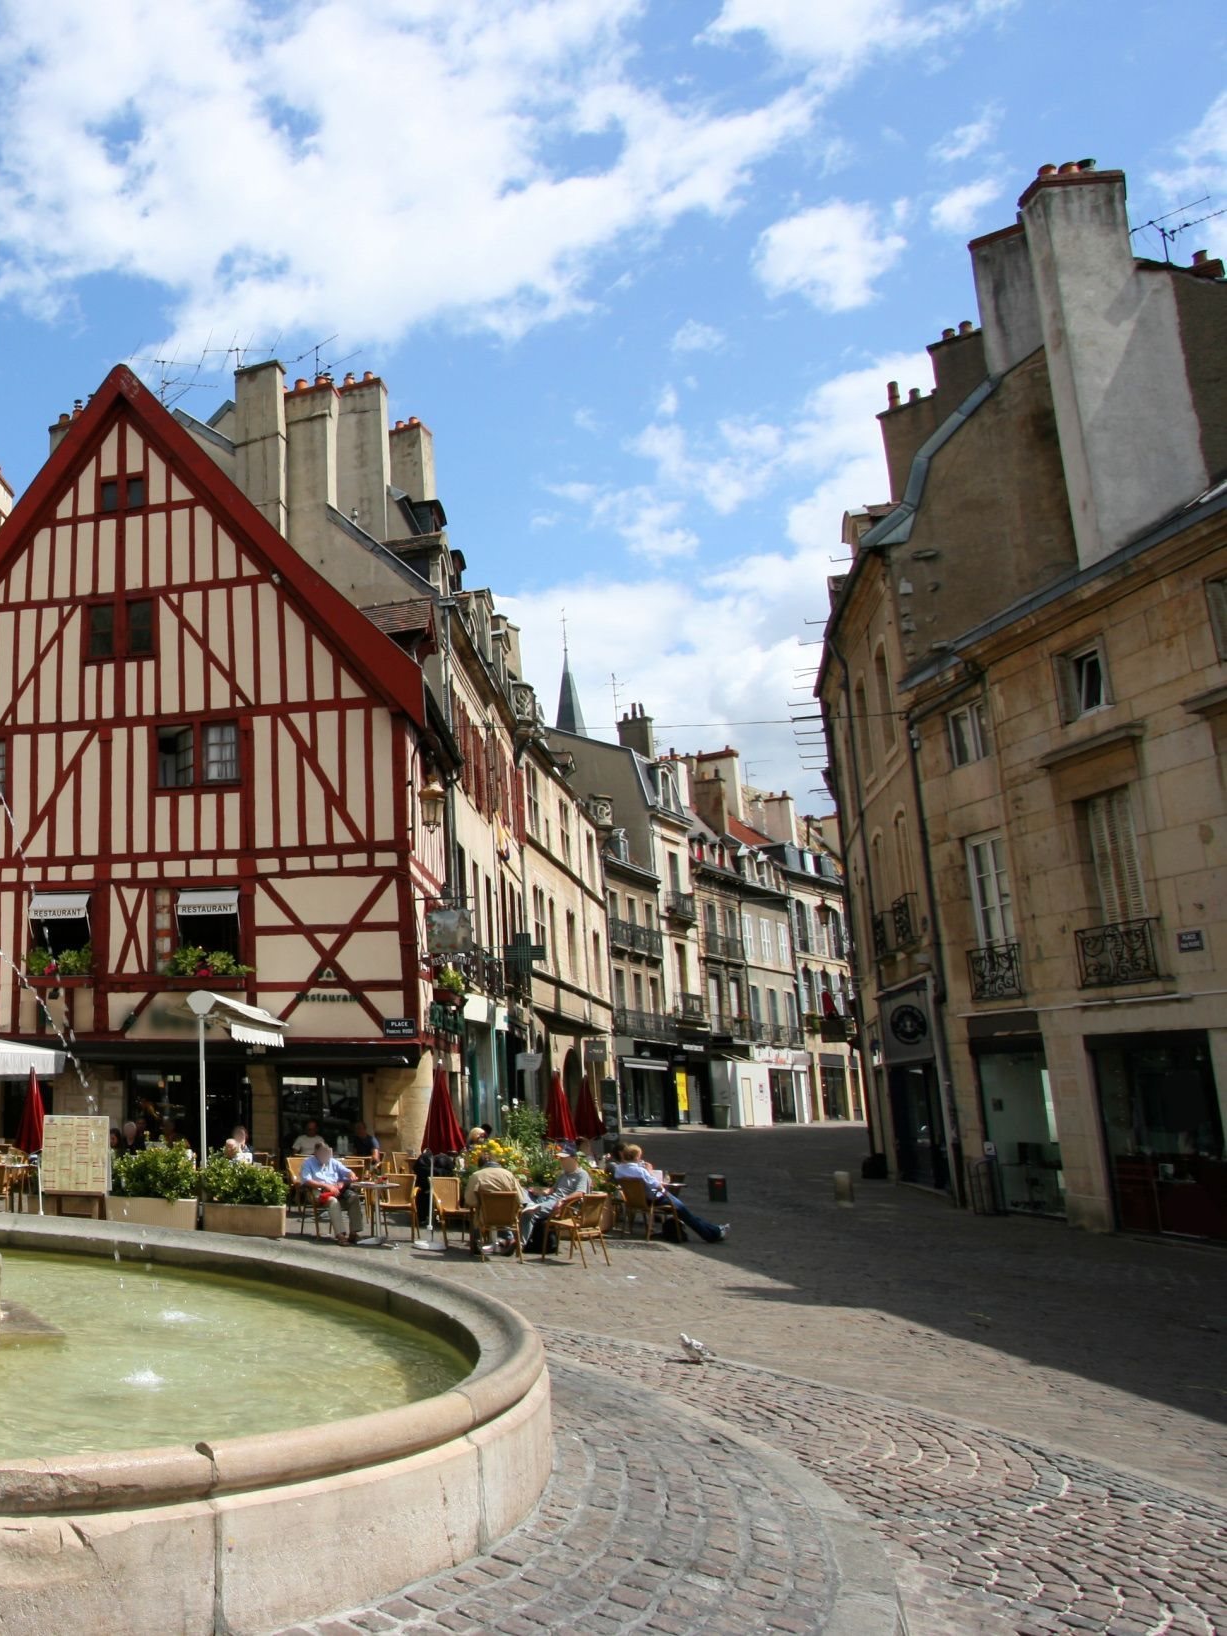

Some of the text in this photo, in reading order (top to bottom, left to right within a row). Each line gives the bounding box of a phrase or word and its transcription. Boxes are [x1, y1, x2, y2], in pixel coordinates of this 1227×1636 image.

[33, 909, 81, 917] RESTAURANT
[181, 905, 233, 913] RESTAURANT
[431, 953, 472, 966] RESTAURANT
